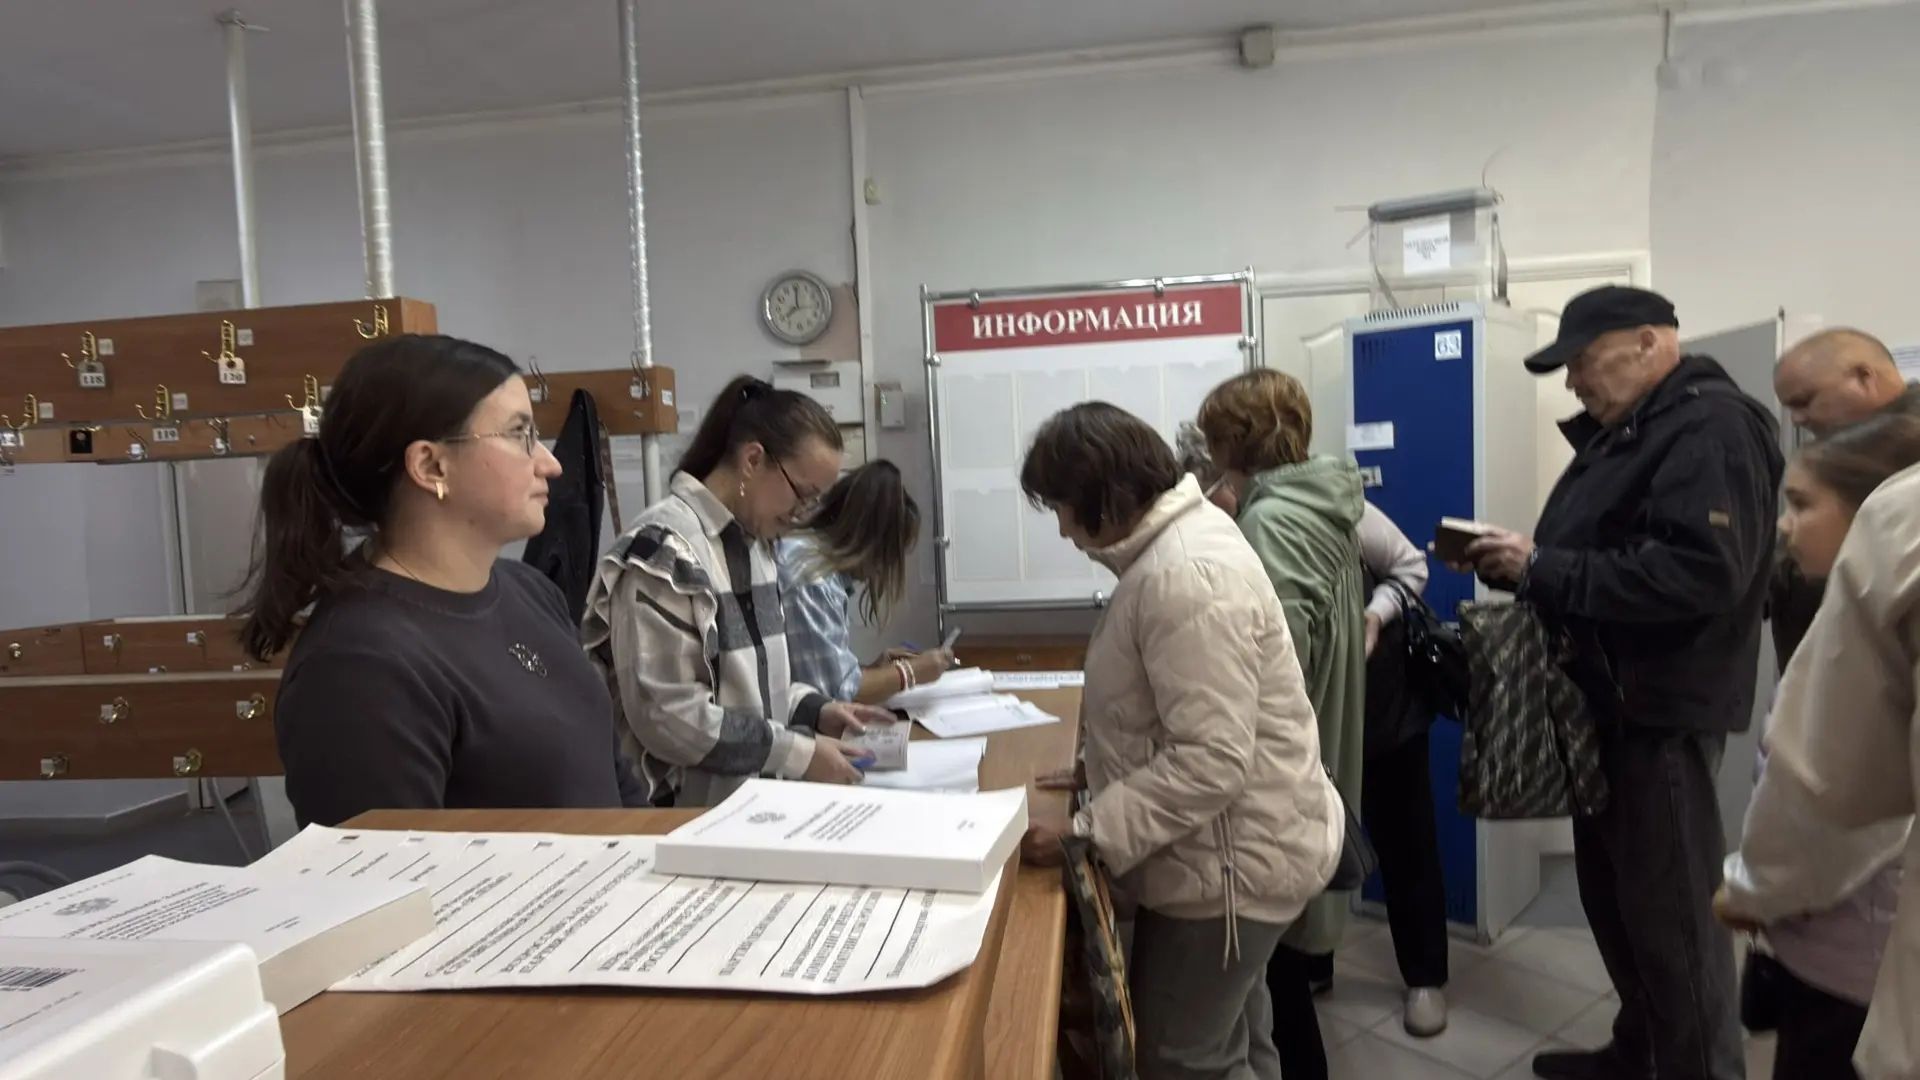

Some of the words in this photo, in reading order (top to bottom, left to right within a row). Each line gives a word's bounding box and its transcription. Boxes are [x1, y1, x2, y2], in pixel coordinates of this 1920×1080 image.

[972, 301, 1203, 339] ИНФОРМАЦИЯ
[223, 372, 243, 382] 120
[157, 430, 177, 439] 119
